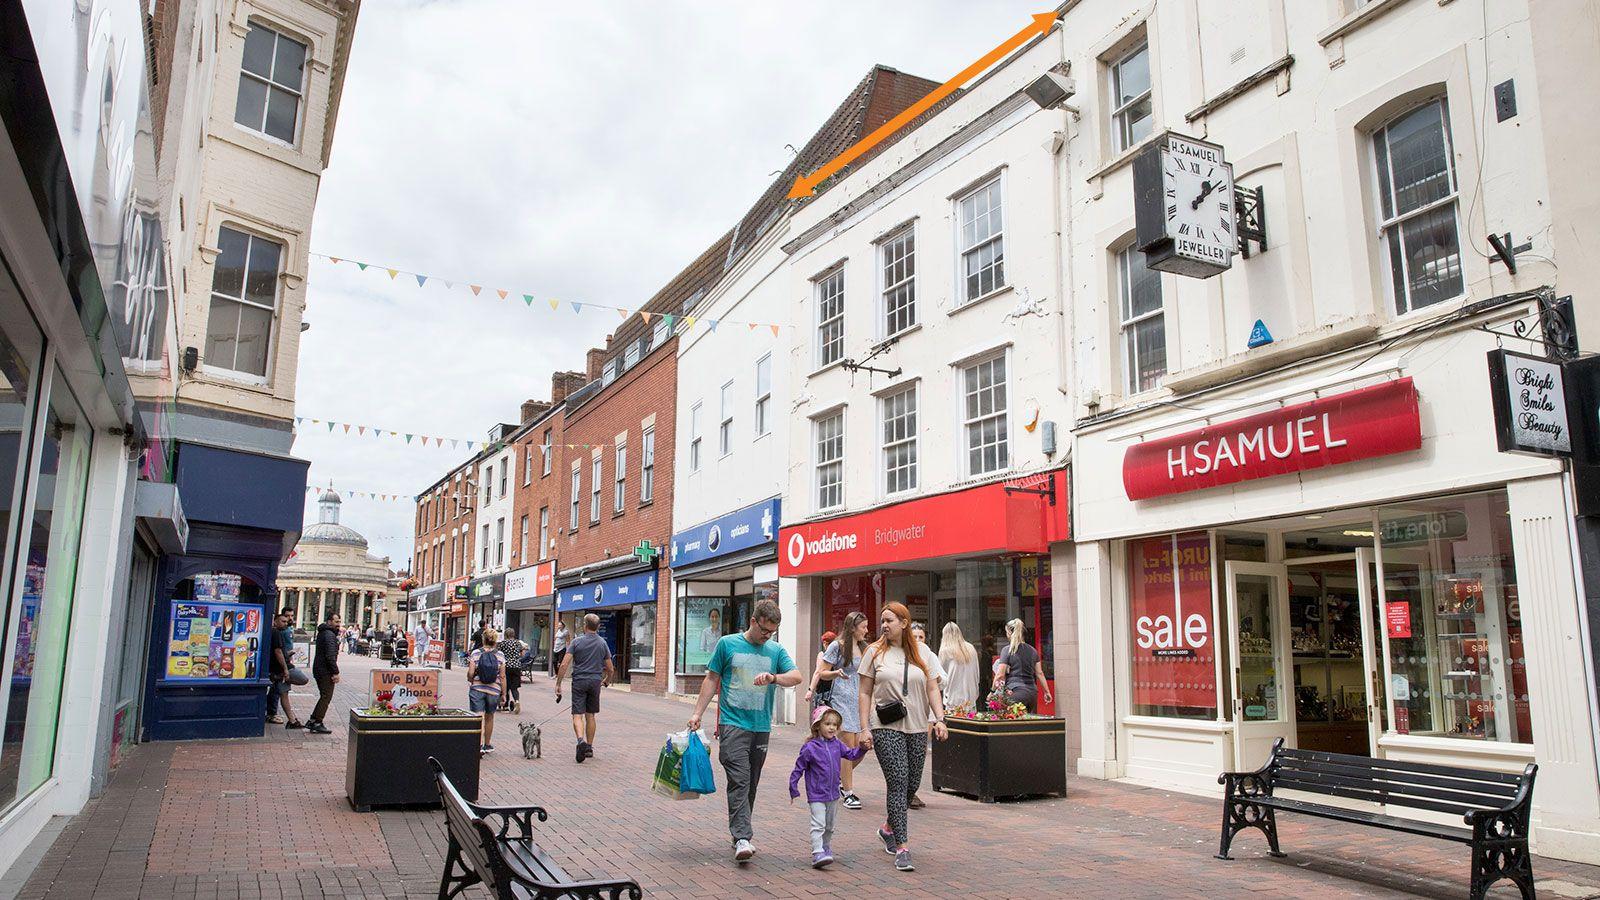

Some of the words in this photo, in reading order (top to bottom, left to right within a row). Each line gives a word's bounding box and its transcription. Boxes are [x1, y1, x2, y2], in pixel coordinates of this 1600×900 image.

[1171, 141, 1218, 163] H.SAMUEL
[1178, 239, 1225, 260] JEWELLER
[1514, 367, 1555, 395] Bright
[1520, 388, 1556, 411] Smiles
[1518, 411, 1563, 440] Beauty
[1167, 412, 1348, 479] H.SAMUEL
[730, 523, 750, 539] opticians
[874, 523, 926, 546] Bridgwater
[684, 540, 701, 554] pharmacy
[806, 532, 857, 556] vodafone
[510, 577, 524, 590] sense
[381, 673, 401, 684] We
[405, 673, 430, 687] Buy
[399, 687, 433, 697] Phone
